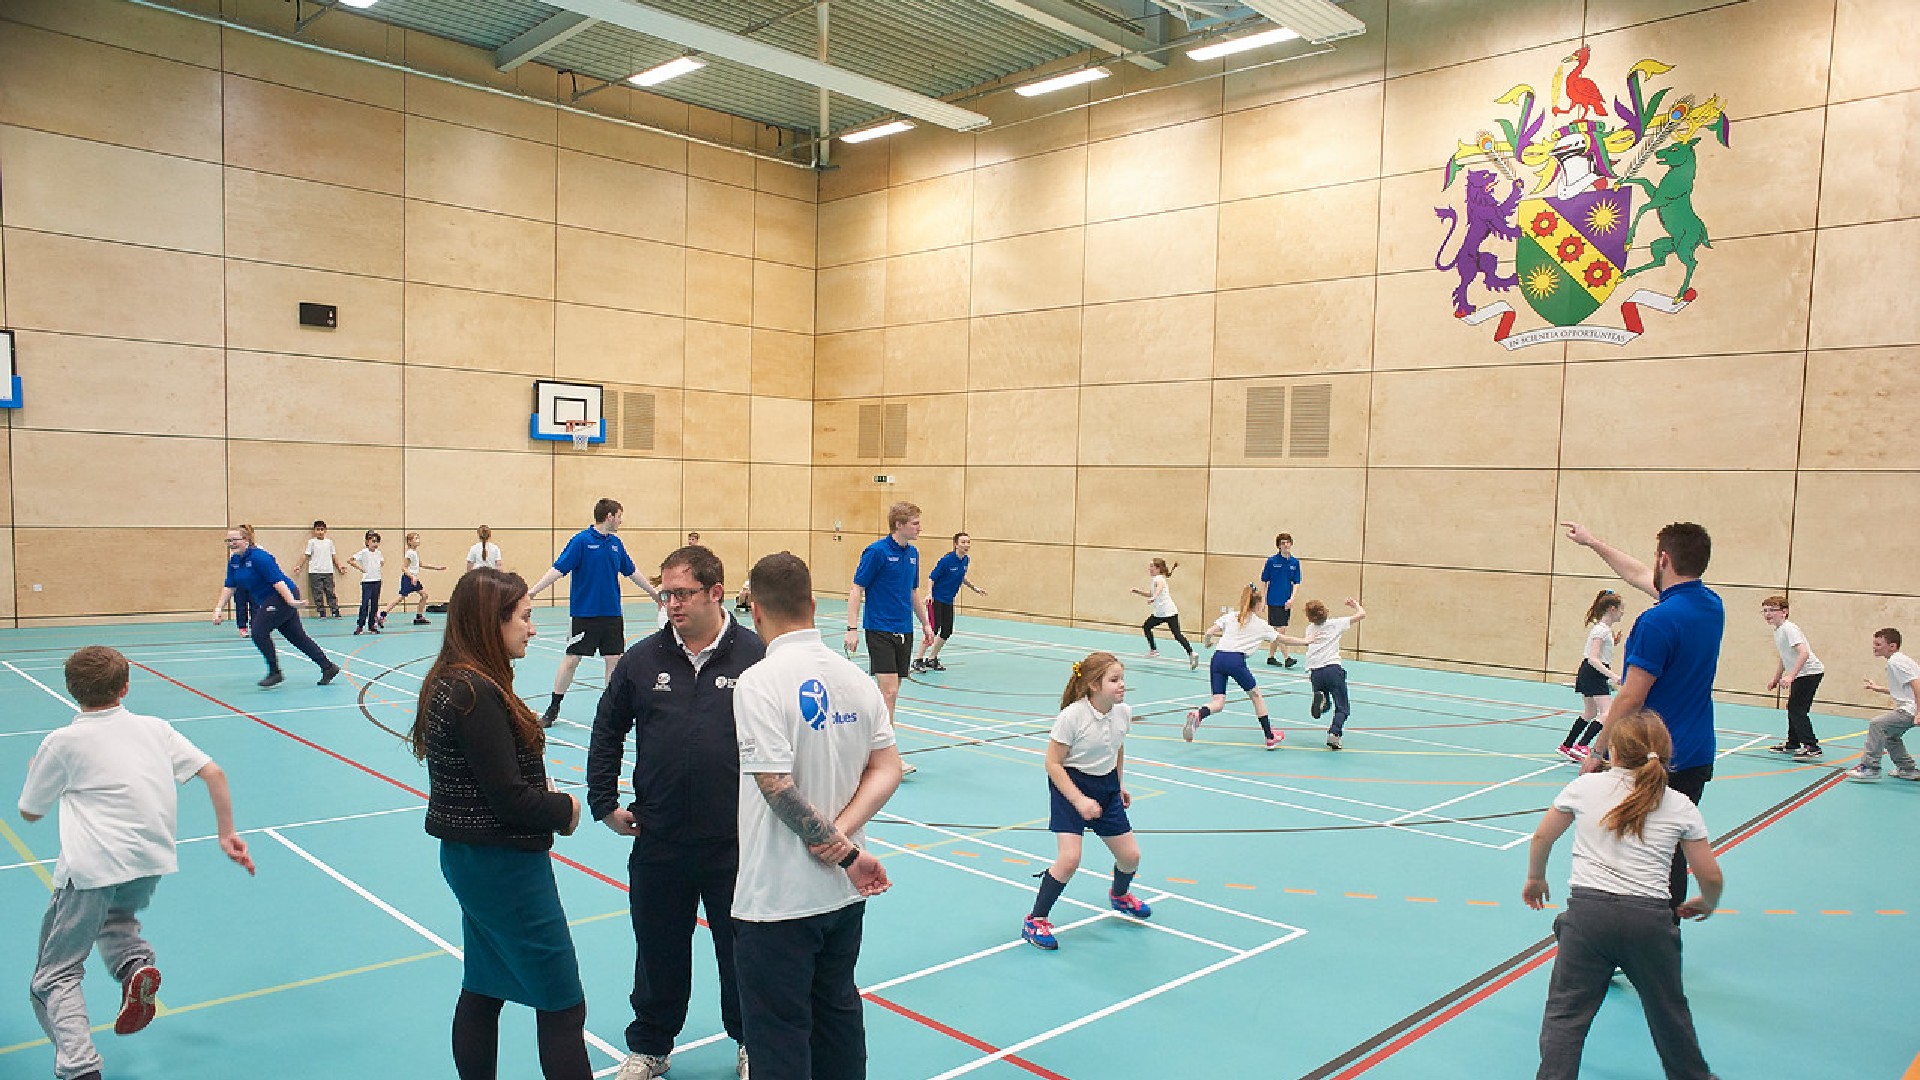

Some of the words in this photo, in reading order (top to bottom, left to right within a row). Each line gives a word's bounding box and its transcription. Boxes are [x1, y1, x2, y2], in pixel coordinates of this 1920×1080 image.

[1509, 338, 1519, 348] IN
[1521, 331, 1558, 343] SCIENTIA
[1560, 329, 1625, 342] OPPORTUNITAS
